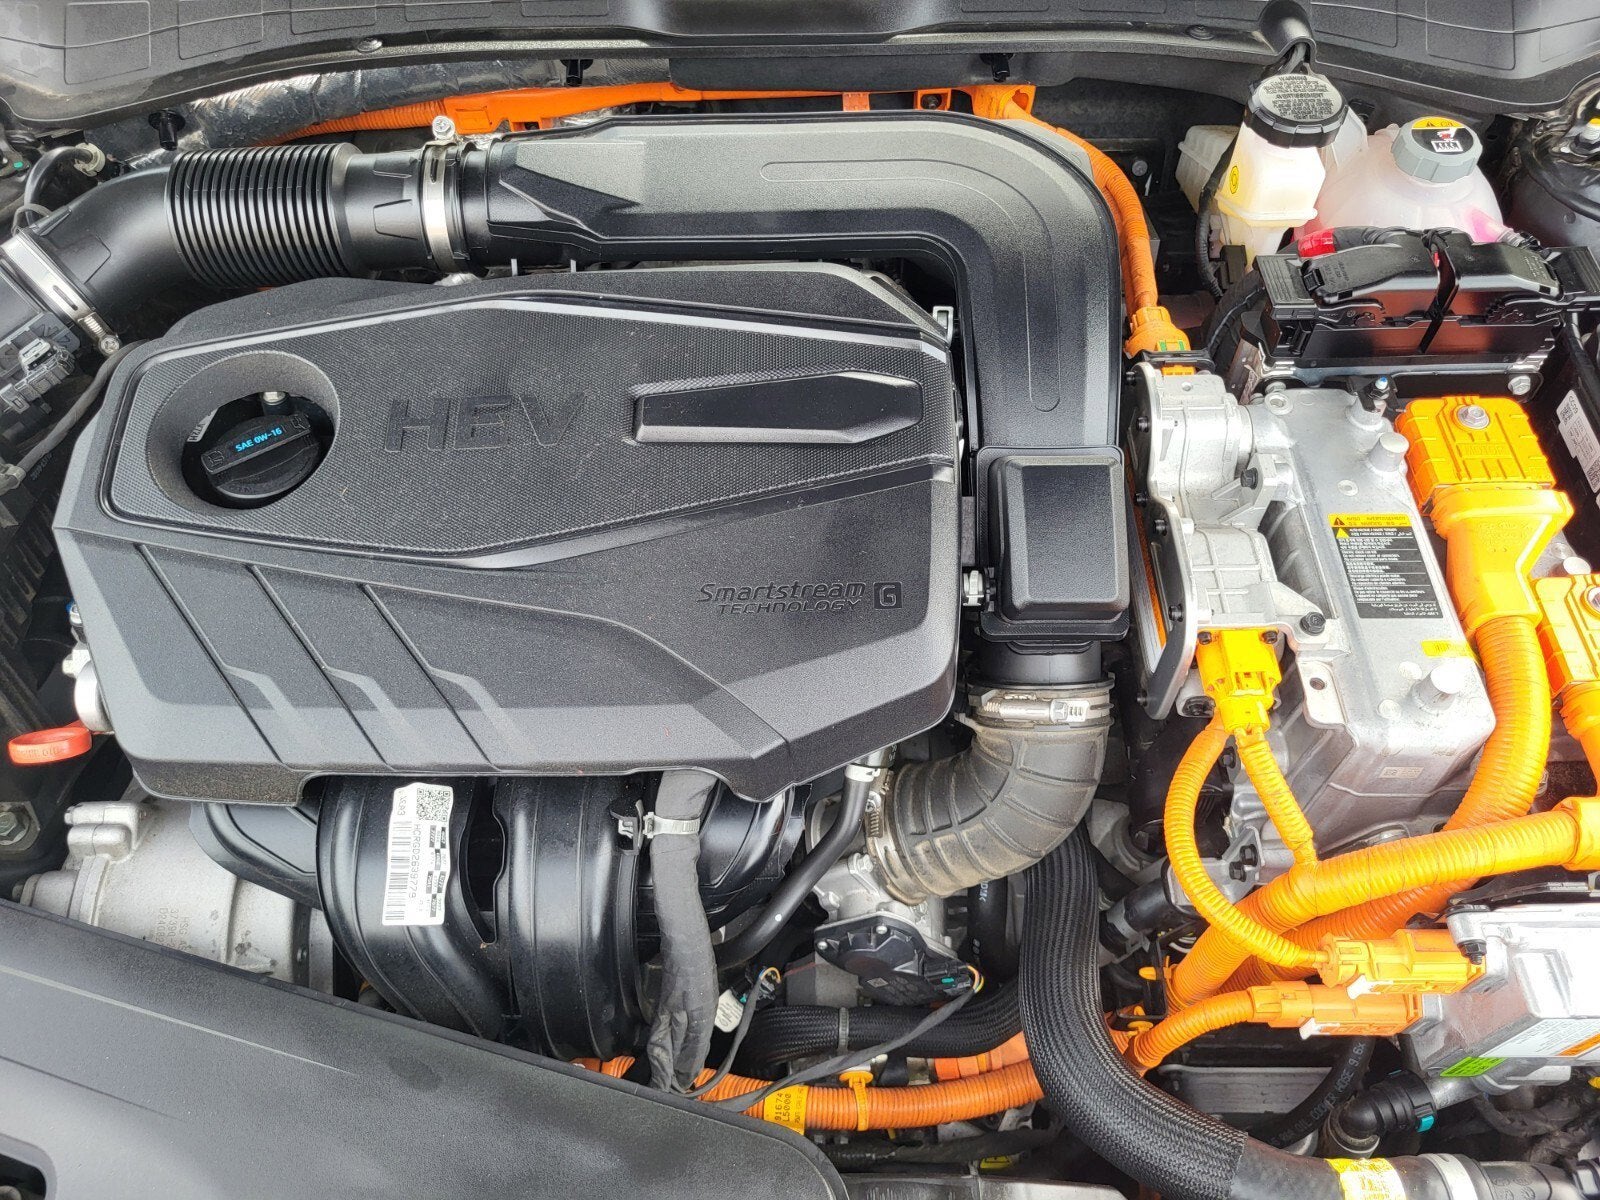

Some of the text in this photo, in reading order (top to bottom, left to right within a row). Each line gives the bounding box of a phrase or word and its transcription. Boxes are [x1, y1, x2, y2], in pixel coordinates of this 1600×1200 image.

[384, 391, 586, 452] HEV
[235, 427, 283, 452] SAE 0W-16
[697, 580, 867, 604] Smartstream
[718, 599, 862, 615] TECHNOLOGY
[1335, 1069, 1354, 1093] HOSE
